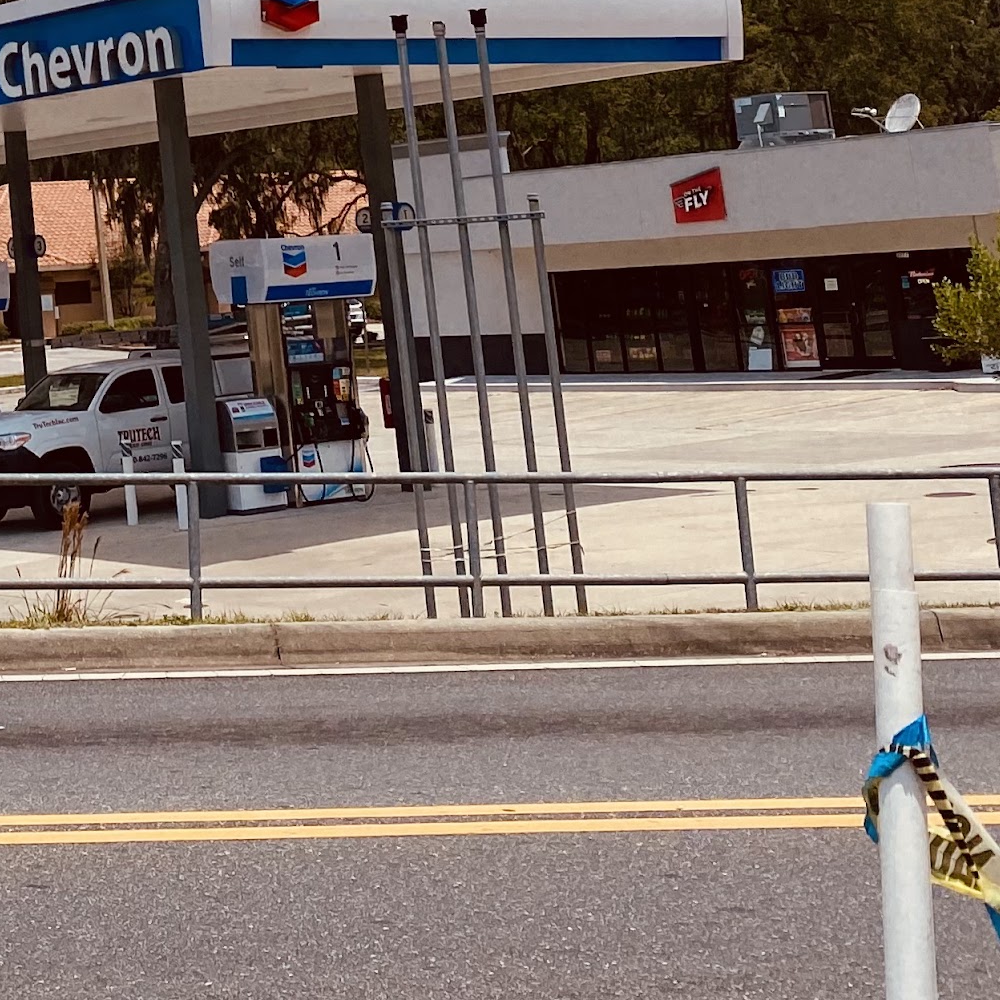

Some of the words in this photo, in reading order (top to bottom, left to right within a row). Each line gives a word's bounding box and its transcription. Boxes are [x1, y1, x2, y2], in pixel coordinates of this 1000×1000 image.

[684, 190, 709, 213] FLY
[362, 213, 369, 224] 2
[36, 241, 42, 252] 3
[332, 241, 341, 261] 1
